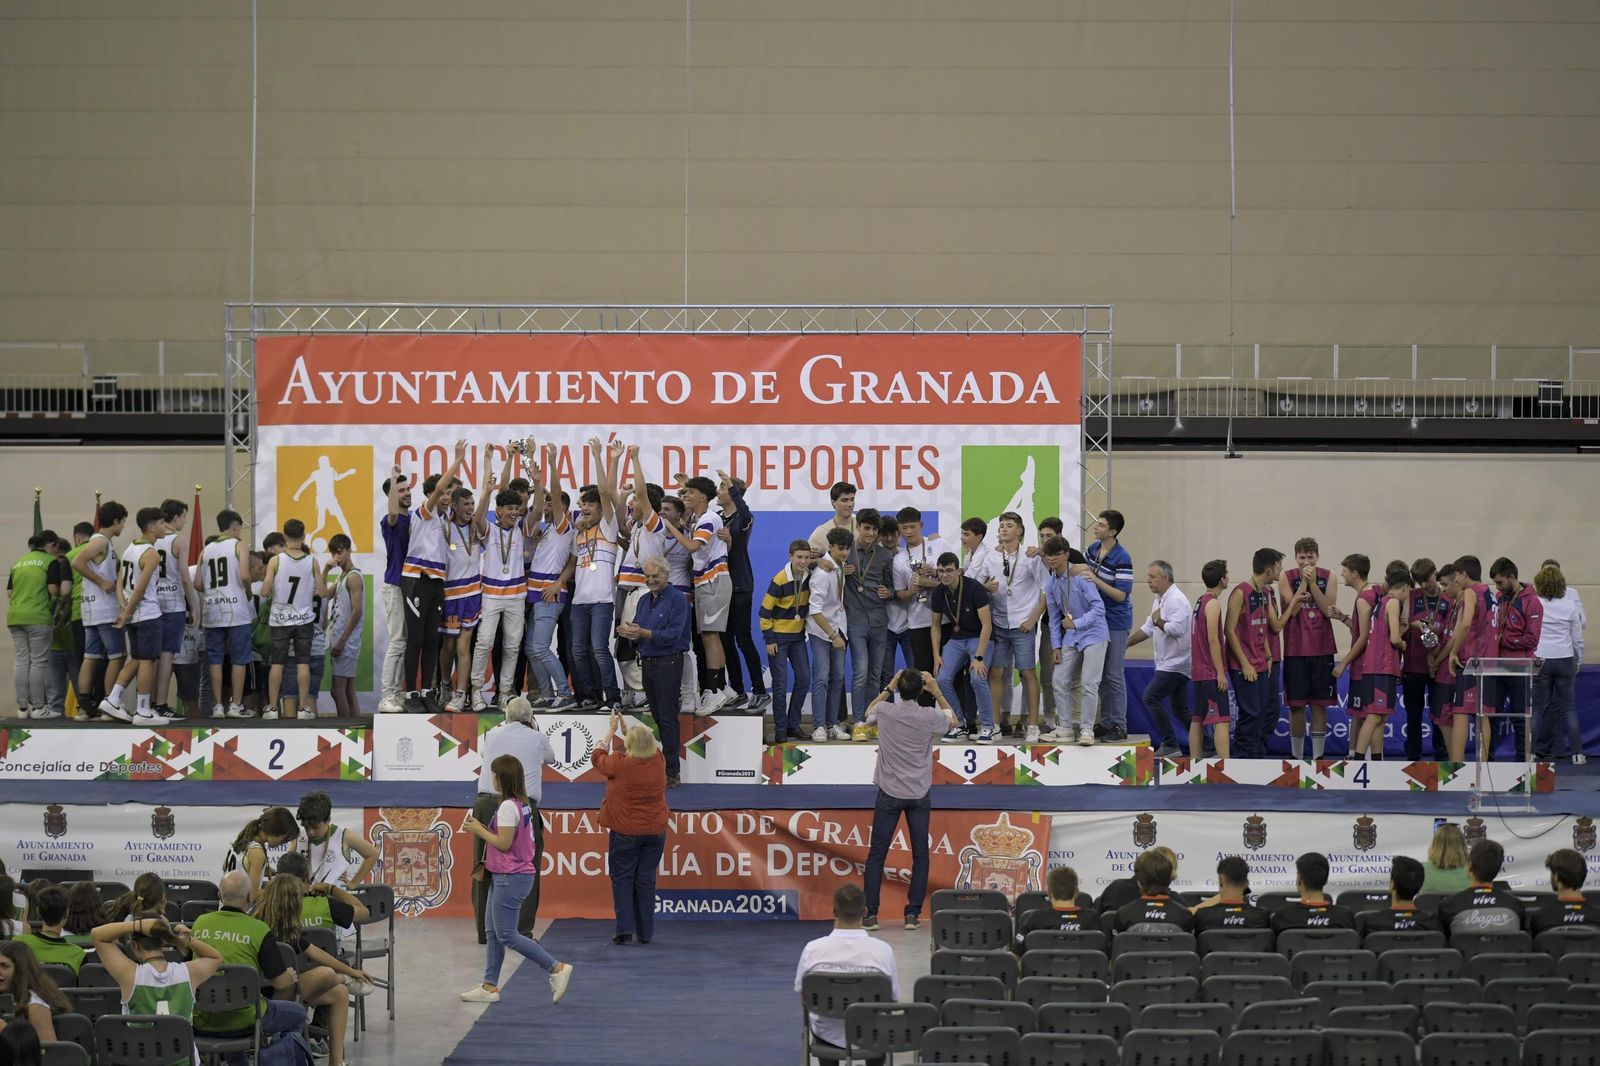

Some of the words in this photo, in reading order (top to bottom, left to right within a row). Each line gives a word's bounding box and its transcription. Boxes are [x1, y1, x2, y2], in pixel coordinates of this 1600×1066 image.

[278, 355, 692, 405] AYUNTAMIENTO
[711, 371, 780, 405] DE
[800, 354, 1060, 405] GRANADA
[730, 445, 941, 491] DEPORTES
[208, 557, 228, 588] 19
[288, 576, 301, 604] 7
[268, 739, 284, 770] 2
[561, 728, 571, 763] 1
[76, 761, 94, 773] de
[100, 761, 162, 775] Deportes
[964, 749, 977, 774] 3
[1352, 763, 1370, 788] 4
[16, 839, 94, 850] AYUNTAMIENTO
[736, 813, 776, 835] DE
[788, 810, 955, 856] GRAAA
[23, 853, 36, 861] DE
[38, 851, 87, 861] GRANADA
[124, 841, 202, 851] AYUNTAMIENTO
[130, 854, 144, 862] DE
[146, 852, 195, 863] GRANADA
[716, 852, 752, 876] DE
[767, 843, 913, 885] DEPORES
[1248, 865, 1287, 874] RANADA
[1348, 865, 1391, 874] GRANAD
[214, 930, 250, 945] SMILO
